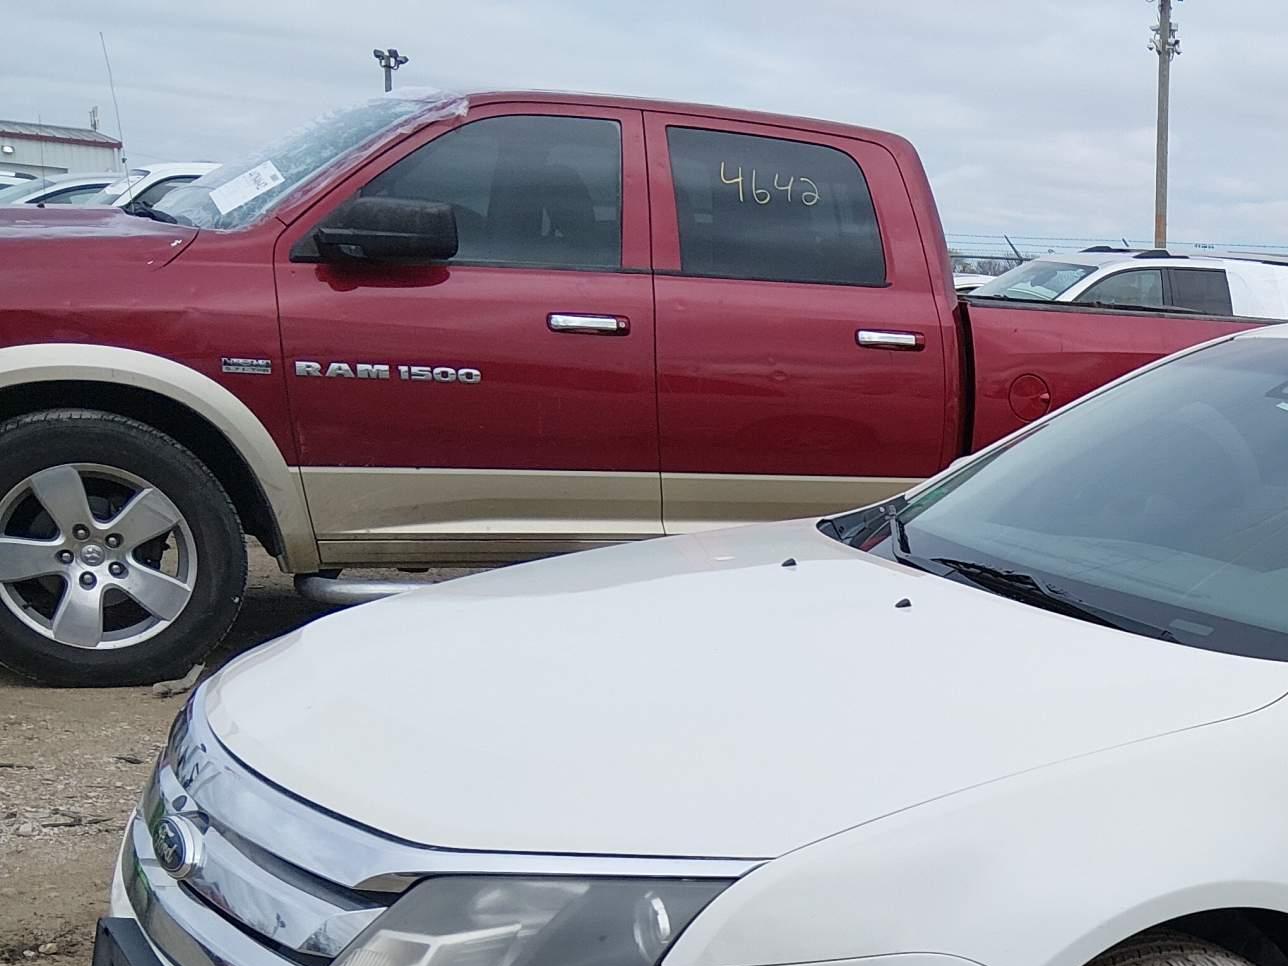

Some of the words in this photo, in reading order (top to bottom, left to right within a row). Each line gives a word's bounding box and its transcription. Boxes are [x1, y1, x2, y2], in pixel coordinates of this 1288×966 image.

[720, 161, 820, 206] 4642
[295, 361, 390, 379] RAM
[398, 365, 482, 384] 1500
